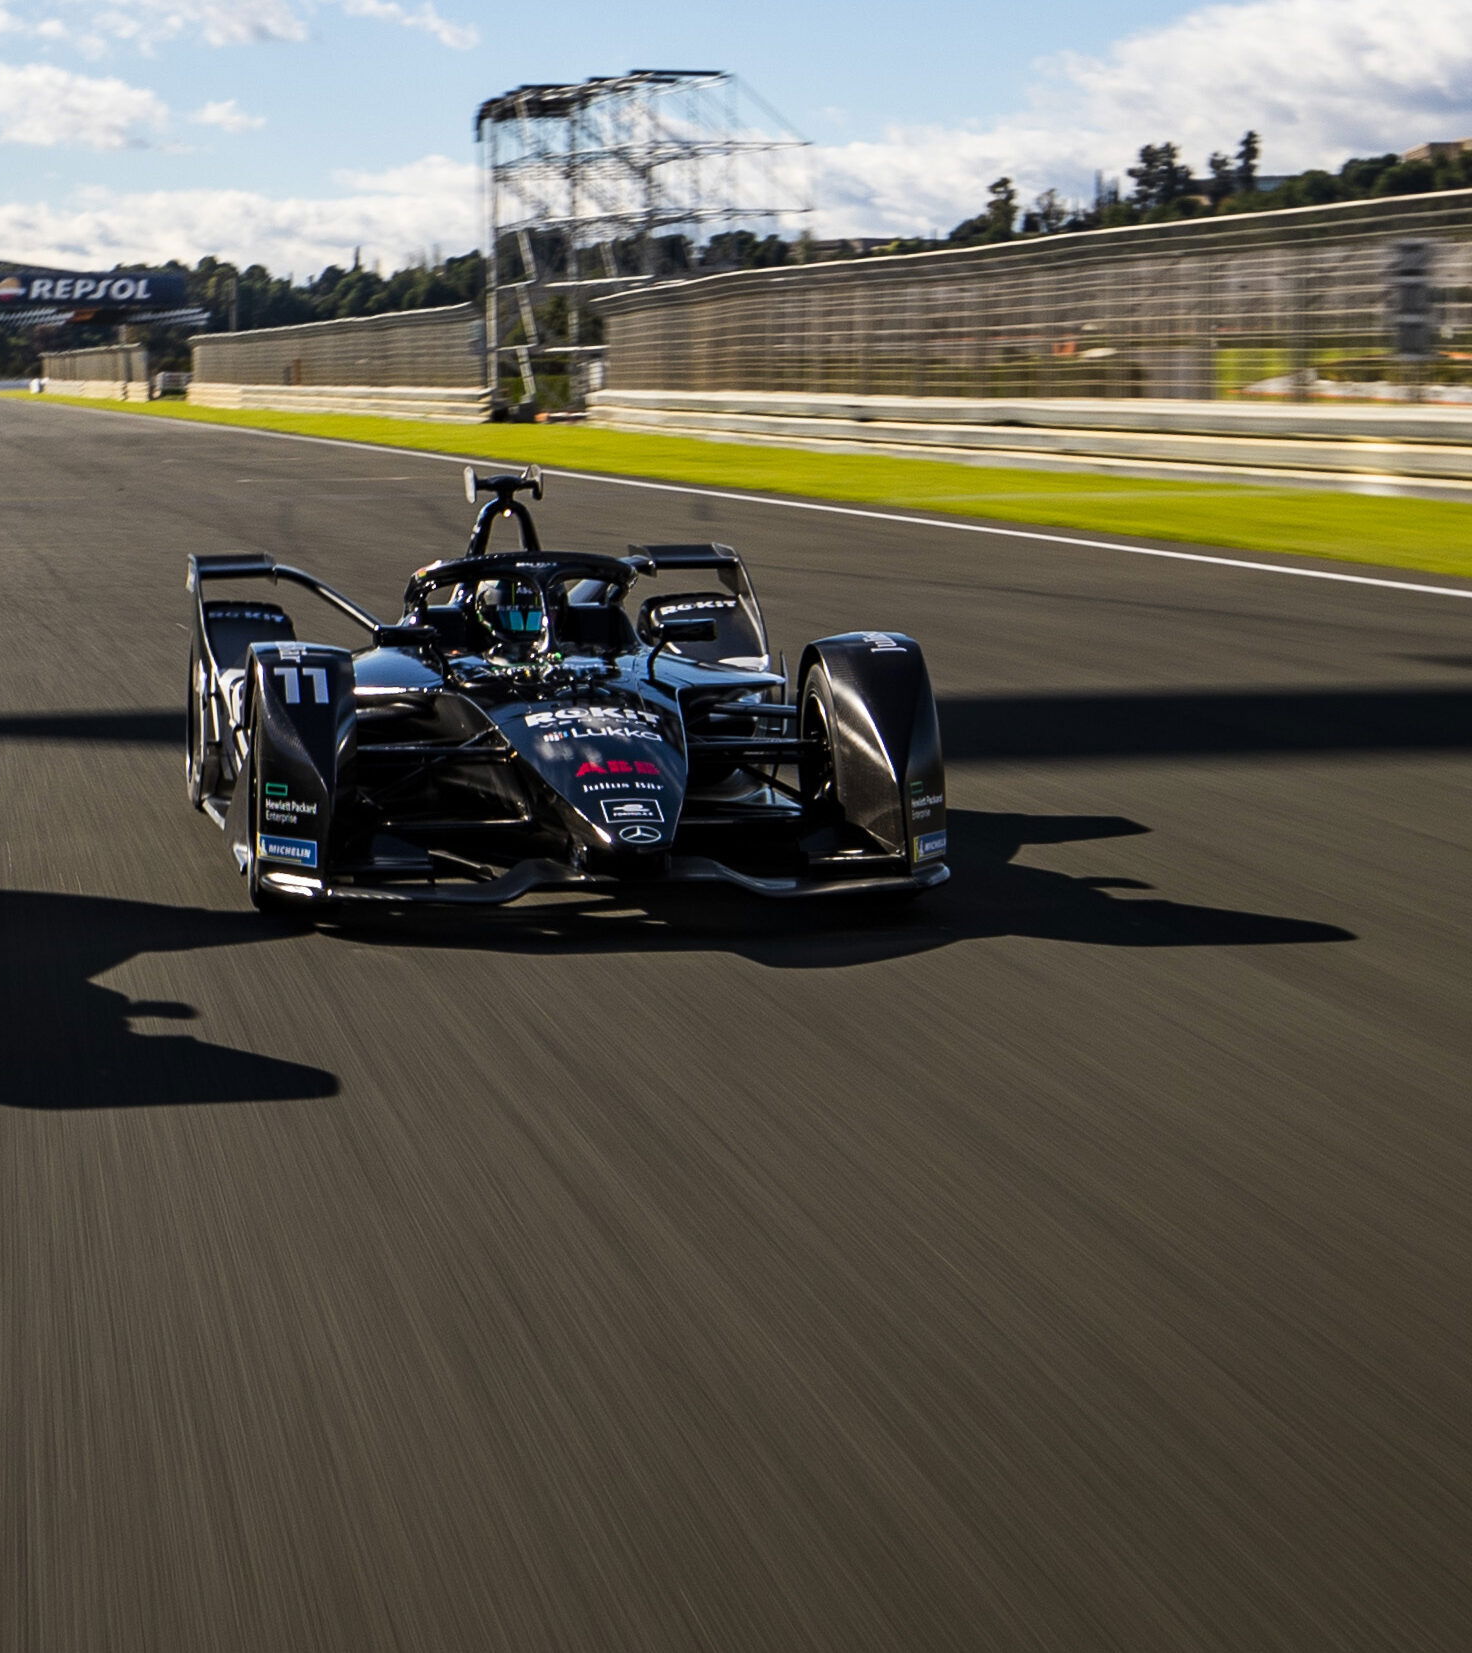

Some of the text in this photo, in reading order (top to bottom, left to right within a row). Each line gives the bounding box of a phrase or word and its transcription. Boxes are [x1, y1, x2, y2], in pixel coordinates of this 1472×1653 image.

[29, 278, 153, 300] REPSOL
[273, 667, 330, 705] 11
[575, 760, 660, 778] ABB
[265, 809, 298, 824] Enterprise
[291, 801, 317, 815] Packard
[268, 843, 312, 860] MICHELIN
